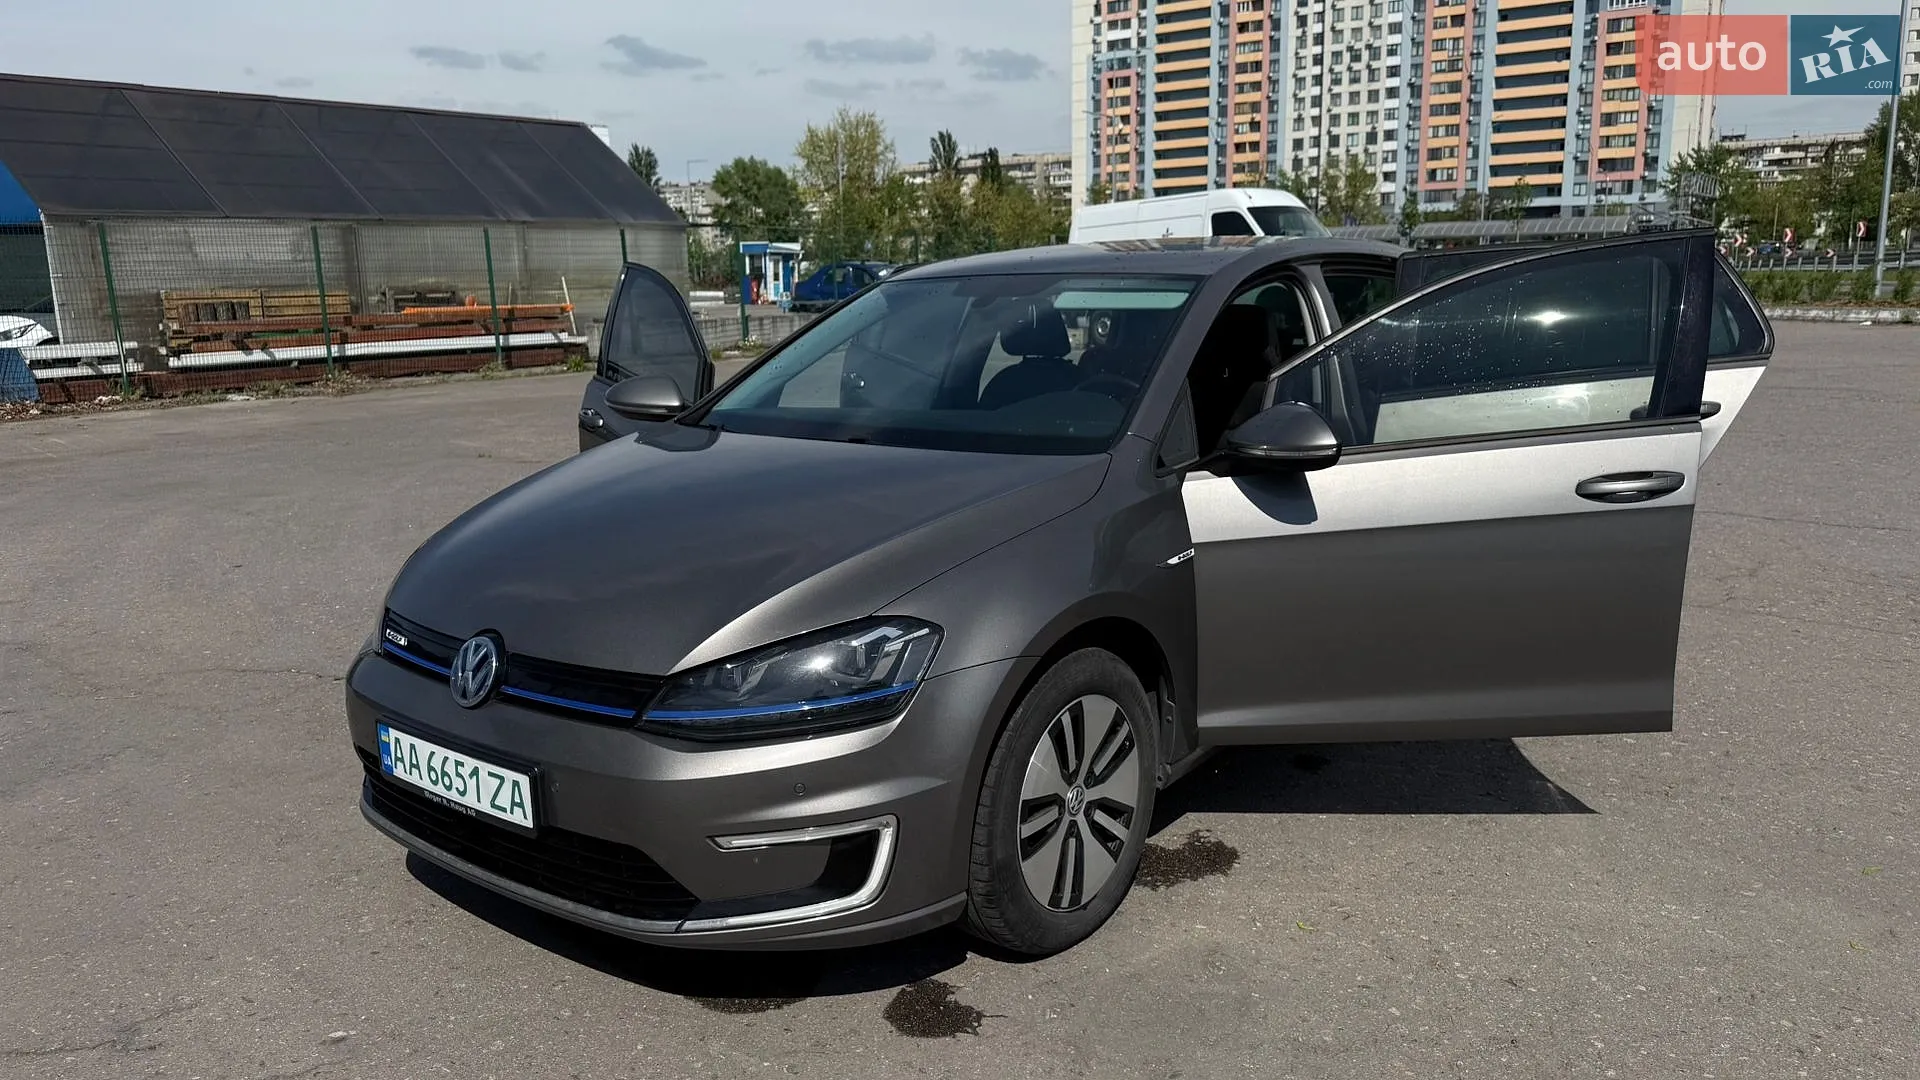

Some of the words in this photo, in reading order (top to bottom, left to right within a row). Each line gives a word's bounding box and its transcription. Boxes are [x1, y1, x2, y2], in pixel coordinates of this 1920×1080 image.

[394, 736, 423, 780] AA
[426, 750, 481, 804] 6651
[487, 770, 528, 820] ZA
